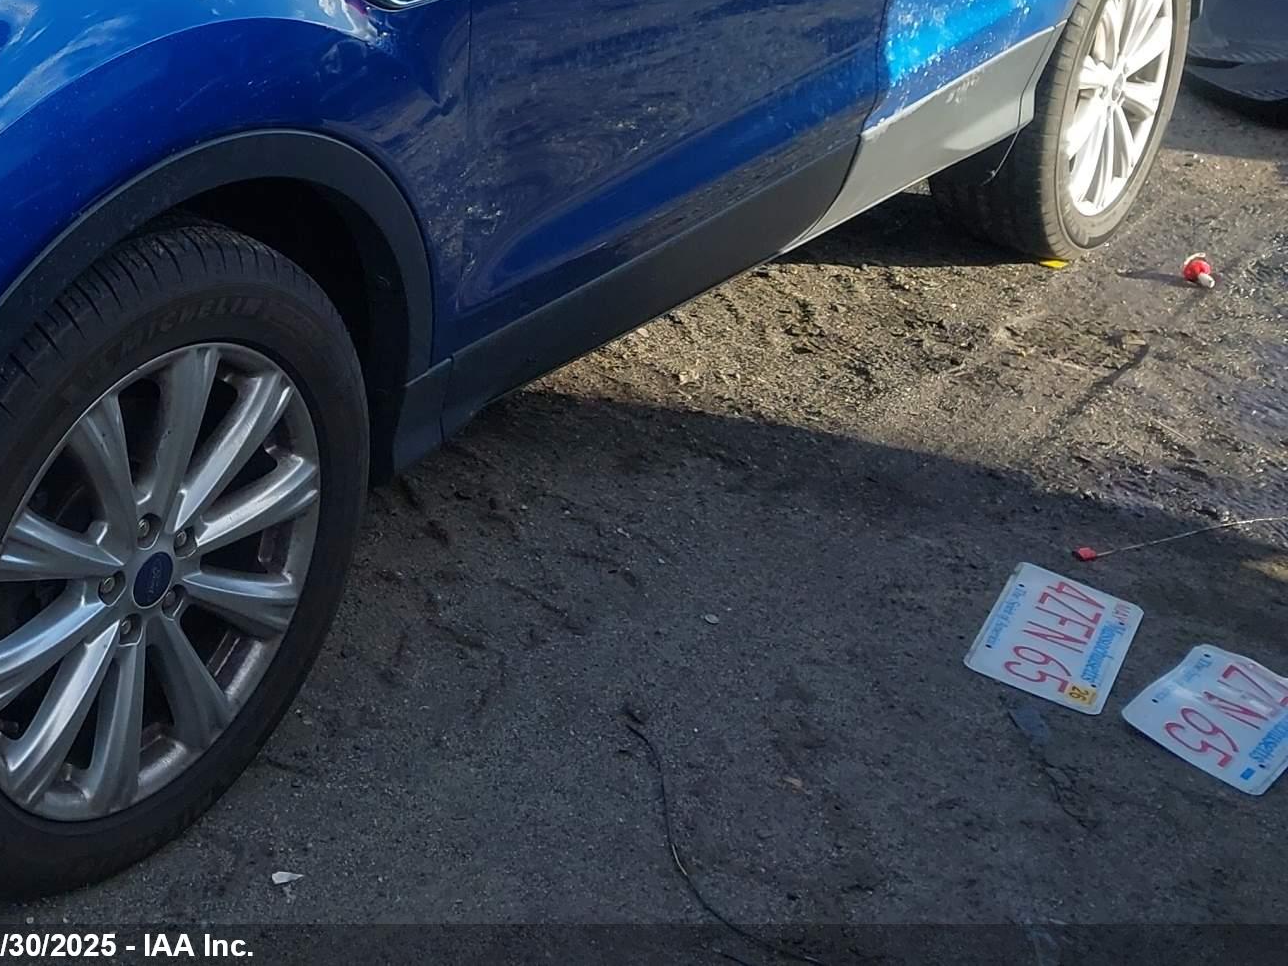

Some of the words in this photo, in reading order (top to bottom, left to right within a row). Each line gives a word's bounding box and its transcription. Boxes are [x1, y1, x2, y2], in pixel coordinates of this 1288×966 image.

[1023, 581, 1106, 654] 4ZFN
[1003, 645, 1072, 694] 65
[1068, 686, 1090, 702] 26
[1165, 707, 1239, 768] 65
